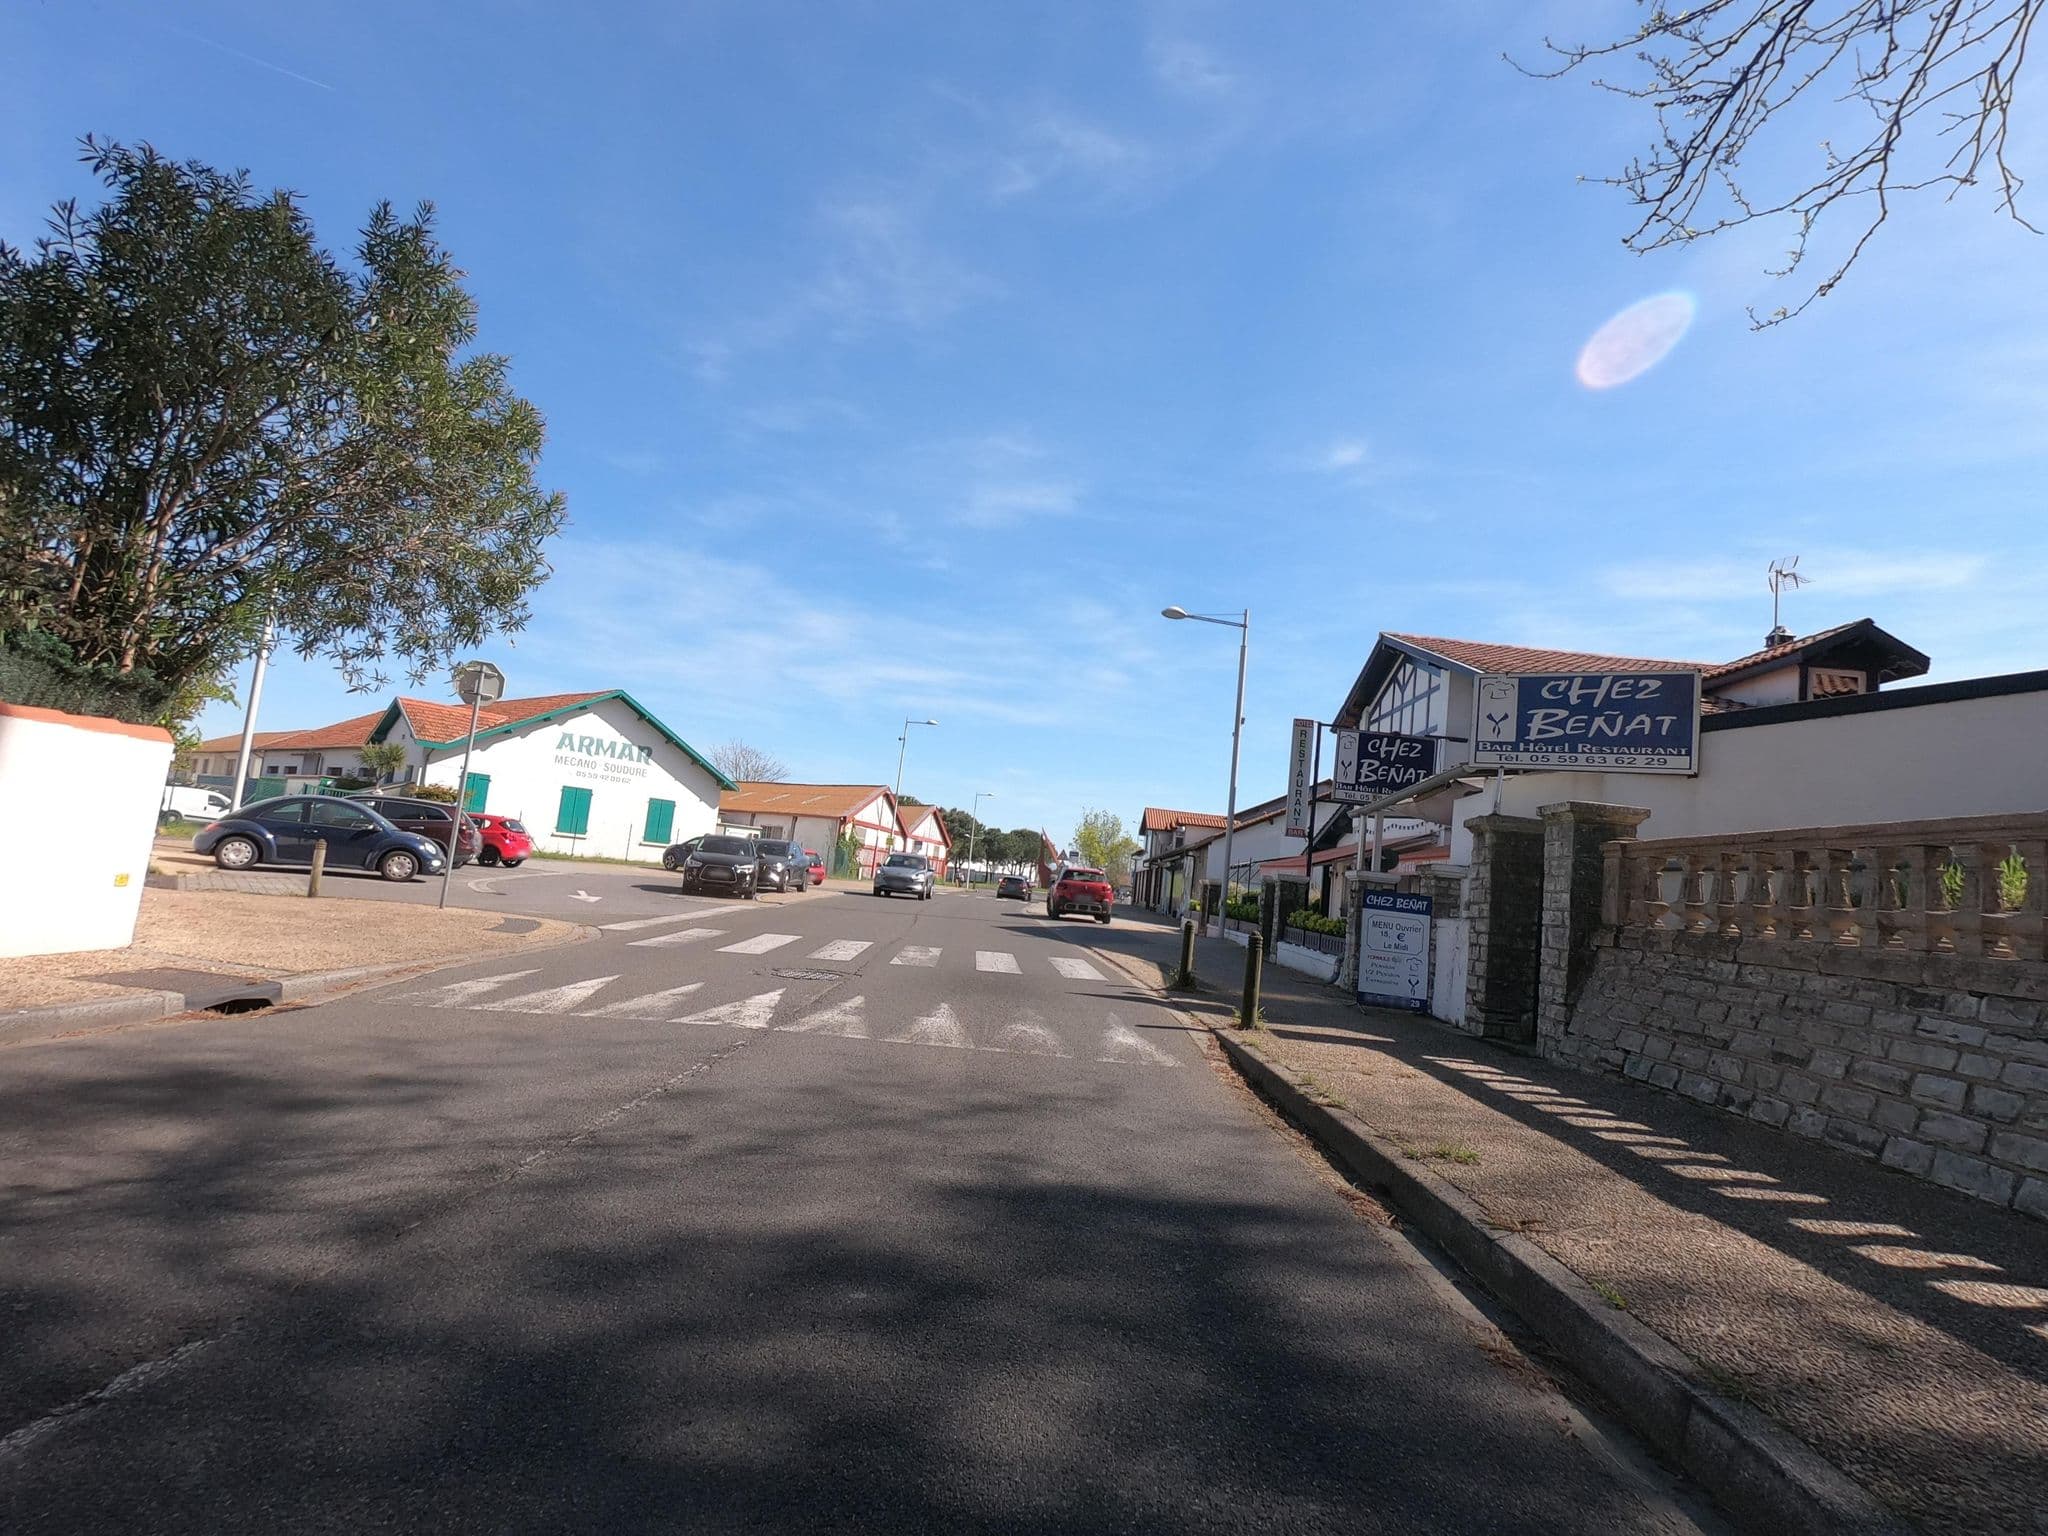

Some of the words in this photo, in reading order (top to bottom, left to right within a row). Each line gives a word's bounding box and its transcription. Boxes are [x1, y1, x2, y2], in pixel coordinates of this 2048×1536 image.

[1540, 675, 1663, 708] CHEZ
[1523, 708, 1678, 741] BEÑAT
[555, 732, 653, 766] ARMAR
[1367, 737, 1422, 761] CHEZ
[1529, 754, 1550, 763] 05
[1557, 755, 1579, 764] 59
[1585, 755, 1607, 765] 63
[1614, 756, 1637, 766] 62
[1644, 757, 1668, 767] 29
[554, 754, 598, 770] MECANO
[603, 762, 648, 779] SOUDURE
[1293, 729, 1308, 827] RESTAURANT
[1358, 759, 1427, 783] BEÑAT
[1366, 894, 1394, 907] CHEZ
[1372, 920, 1394, 930] MENU
